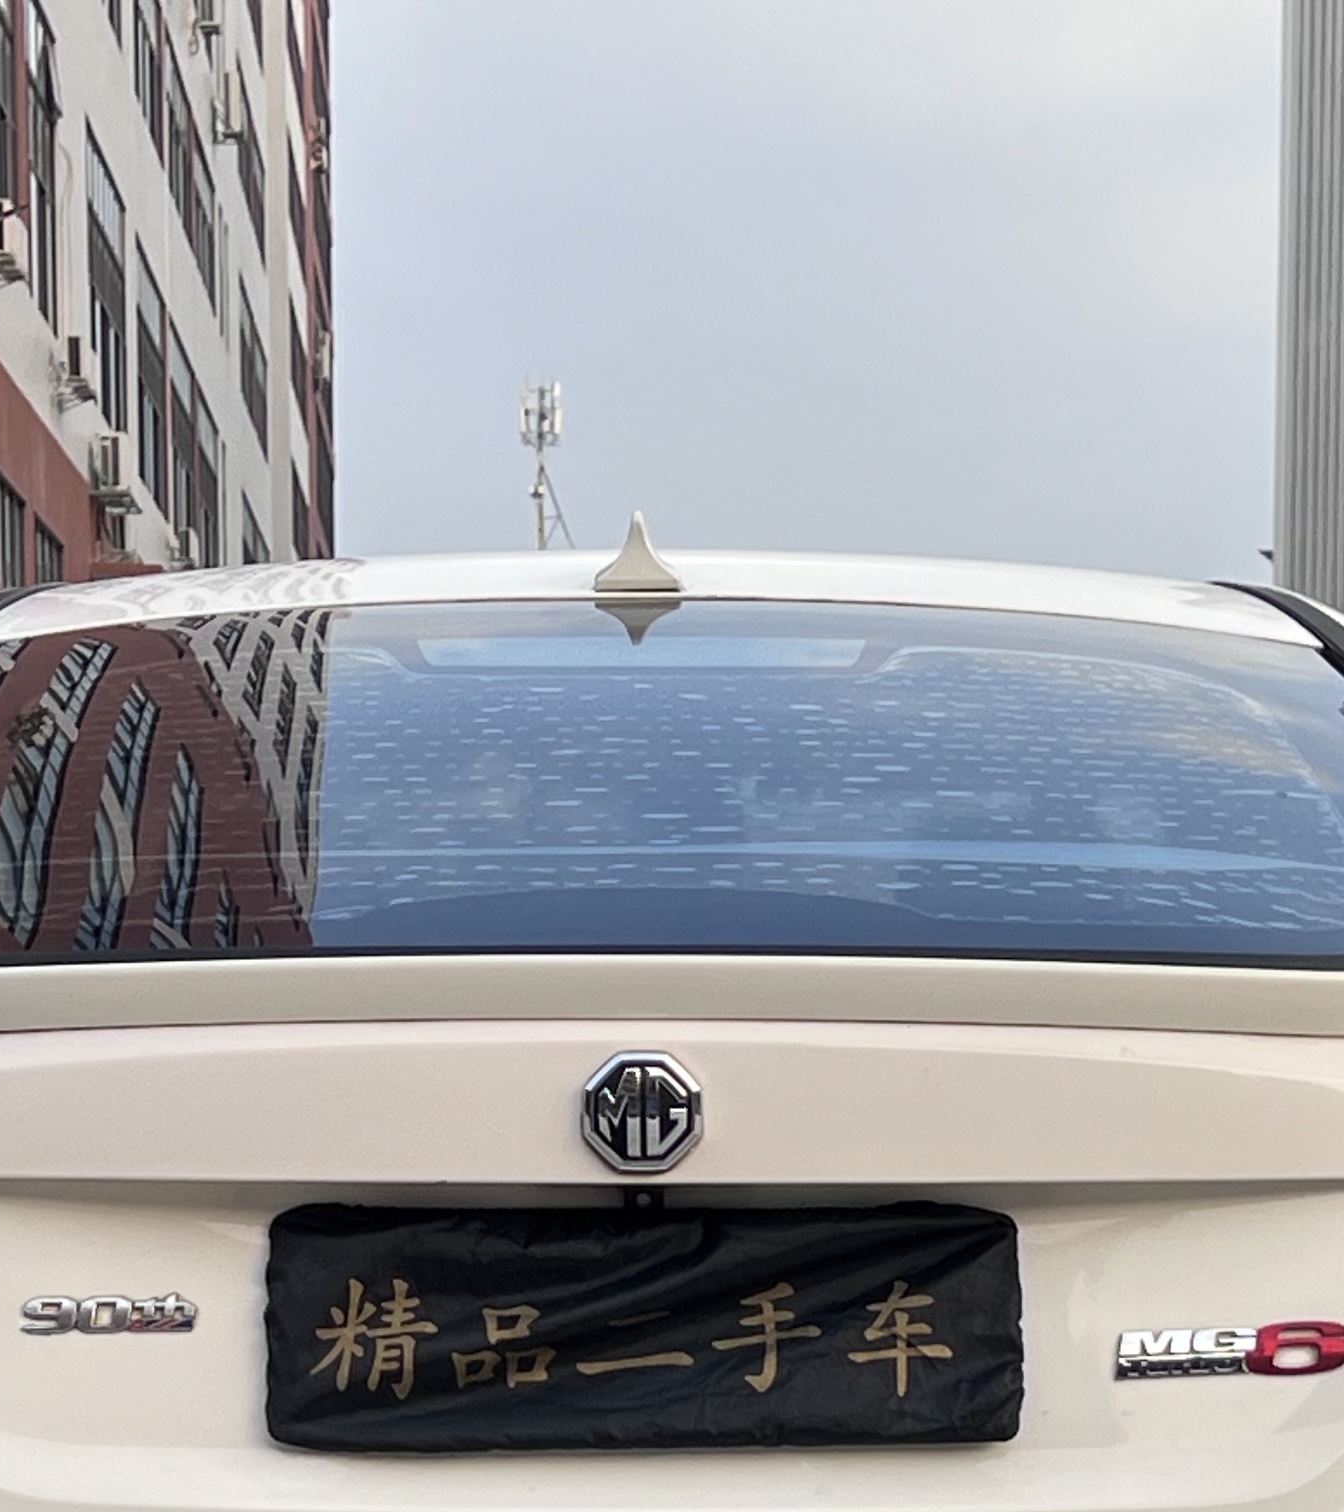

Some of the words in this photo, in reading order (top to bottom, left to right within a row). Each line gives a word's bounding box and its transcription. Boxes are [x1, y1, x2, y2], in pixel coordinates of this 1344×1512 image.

[598, 1066, 688, 1158] MG
[20, 1292, 198, 1336] 90th
[310, 1276, 954, 1400] 精品二手车
